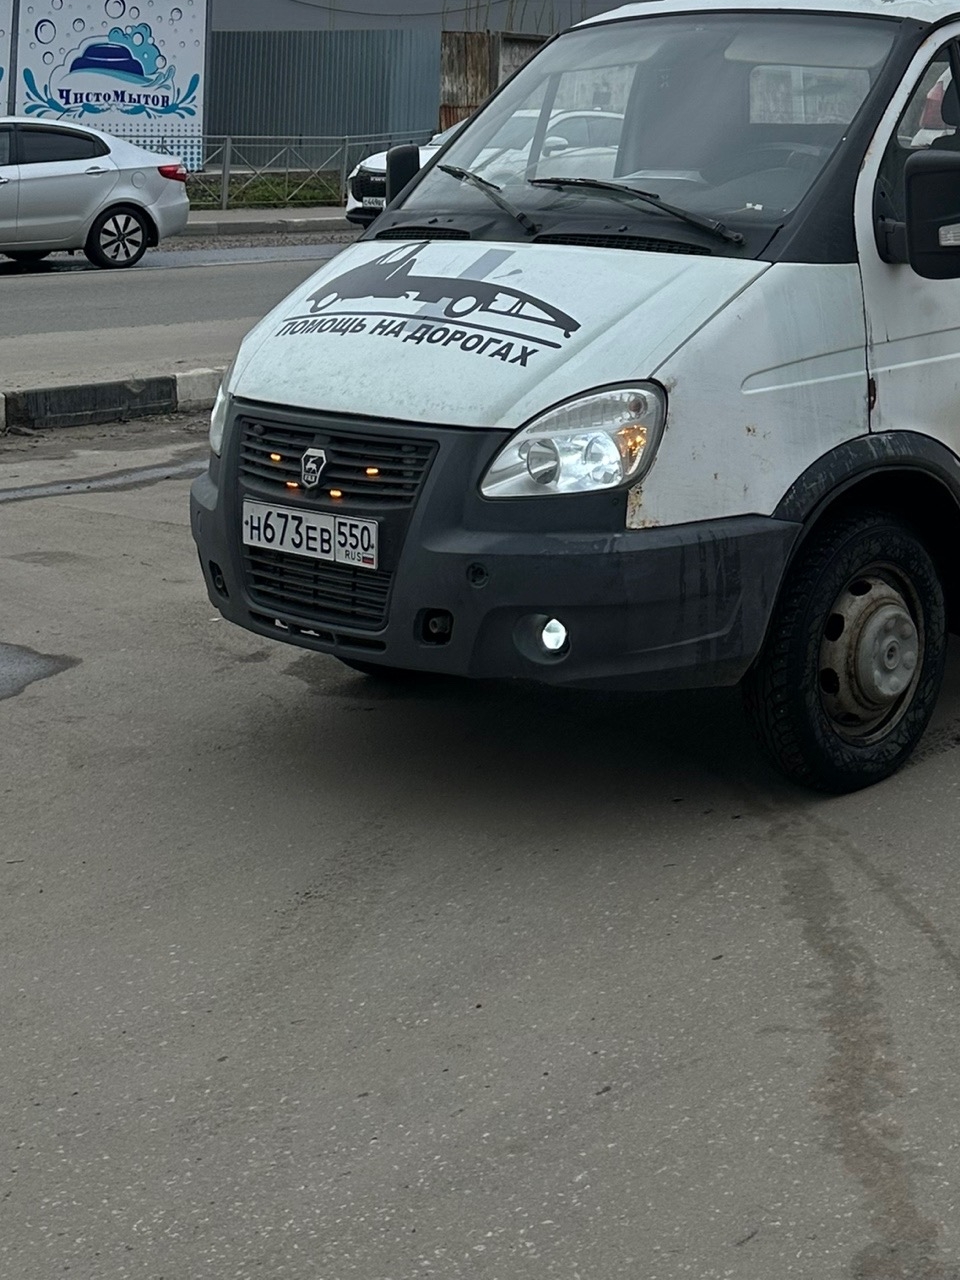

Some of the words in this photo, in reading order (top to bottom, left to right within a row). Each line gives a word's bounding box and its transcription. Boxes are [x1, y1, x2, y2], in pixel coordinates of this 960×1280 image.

[274, 317, 367, 338] ПОМОЩЬ
[368, 319, 408, 338] НА
[402, 324, 539, 368] ДОРОГАХ
[250, 511, 333, 555] Н673ЕВ
[337, 521, 371, 552] 550
[344, 549, 362, 563] RUS
